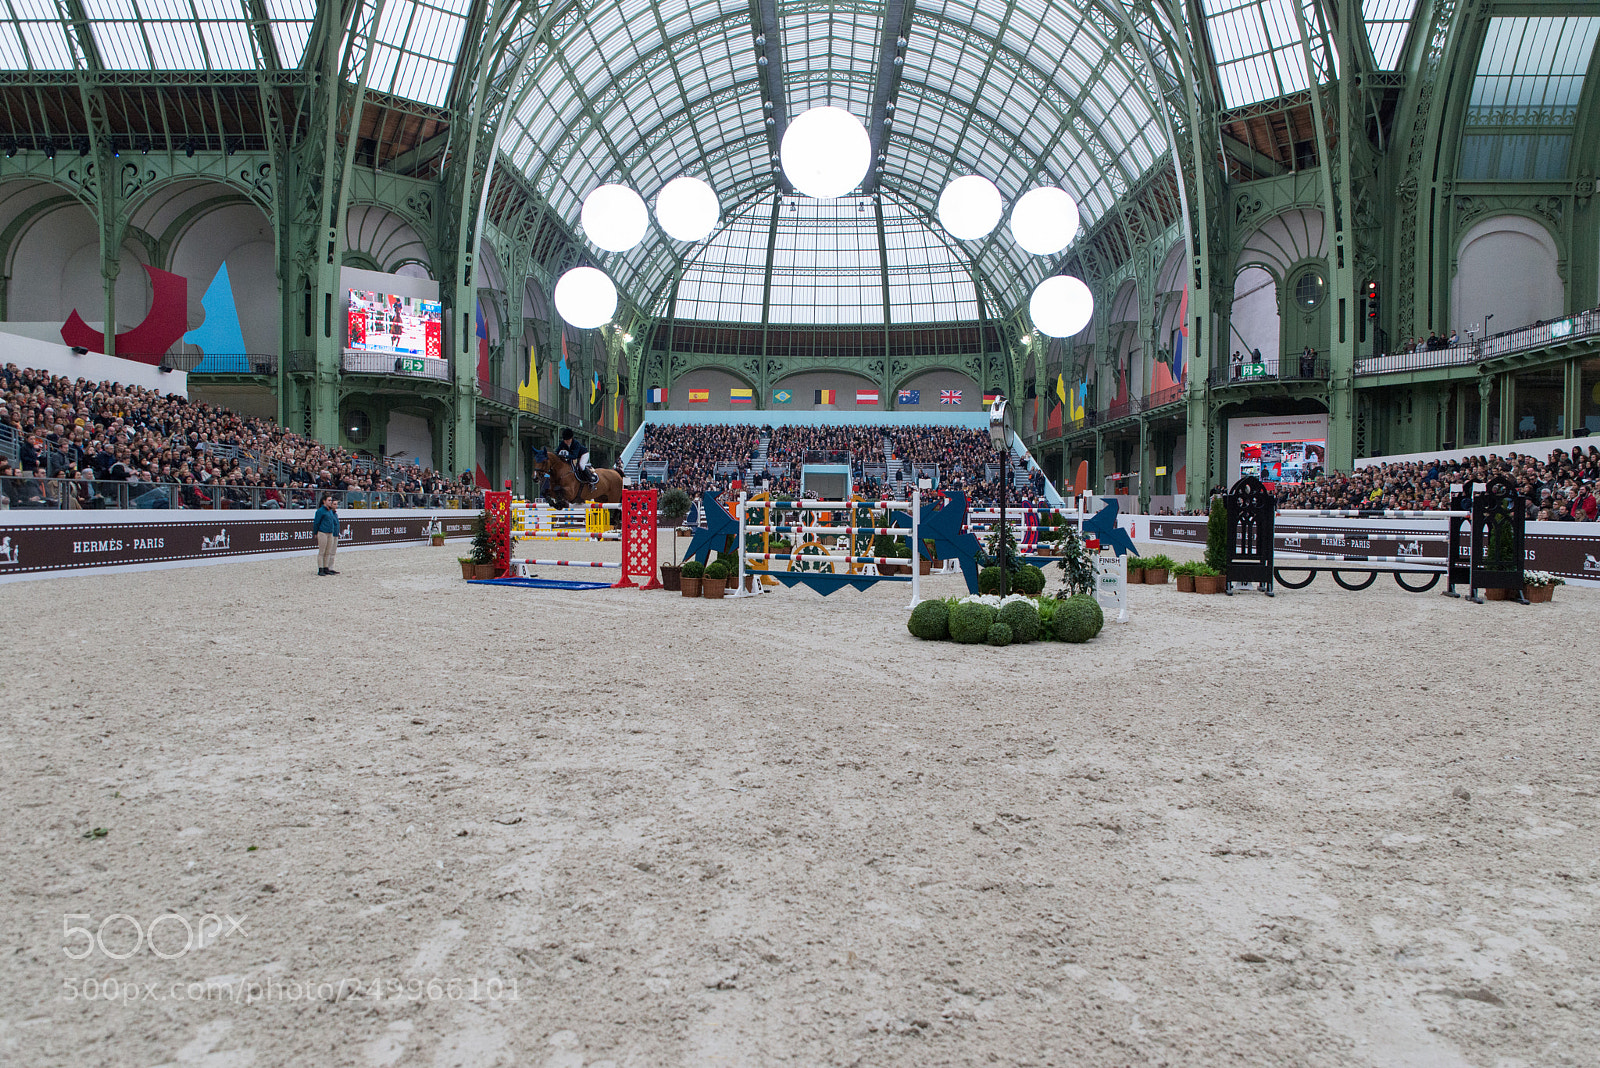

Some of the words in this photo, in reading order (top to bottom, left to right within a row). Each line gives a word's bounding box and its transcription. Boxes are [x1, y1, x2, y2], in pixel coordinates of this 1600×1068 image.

[260, 531, 288, 541] HERMÈS
[294, 531, 313, 539] PARIS
[73, 538, 123, 553] HERMÈS
[134, 538, 164, 549] PARIS
[1351, 539, 1370, 548] PARIS
